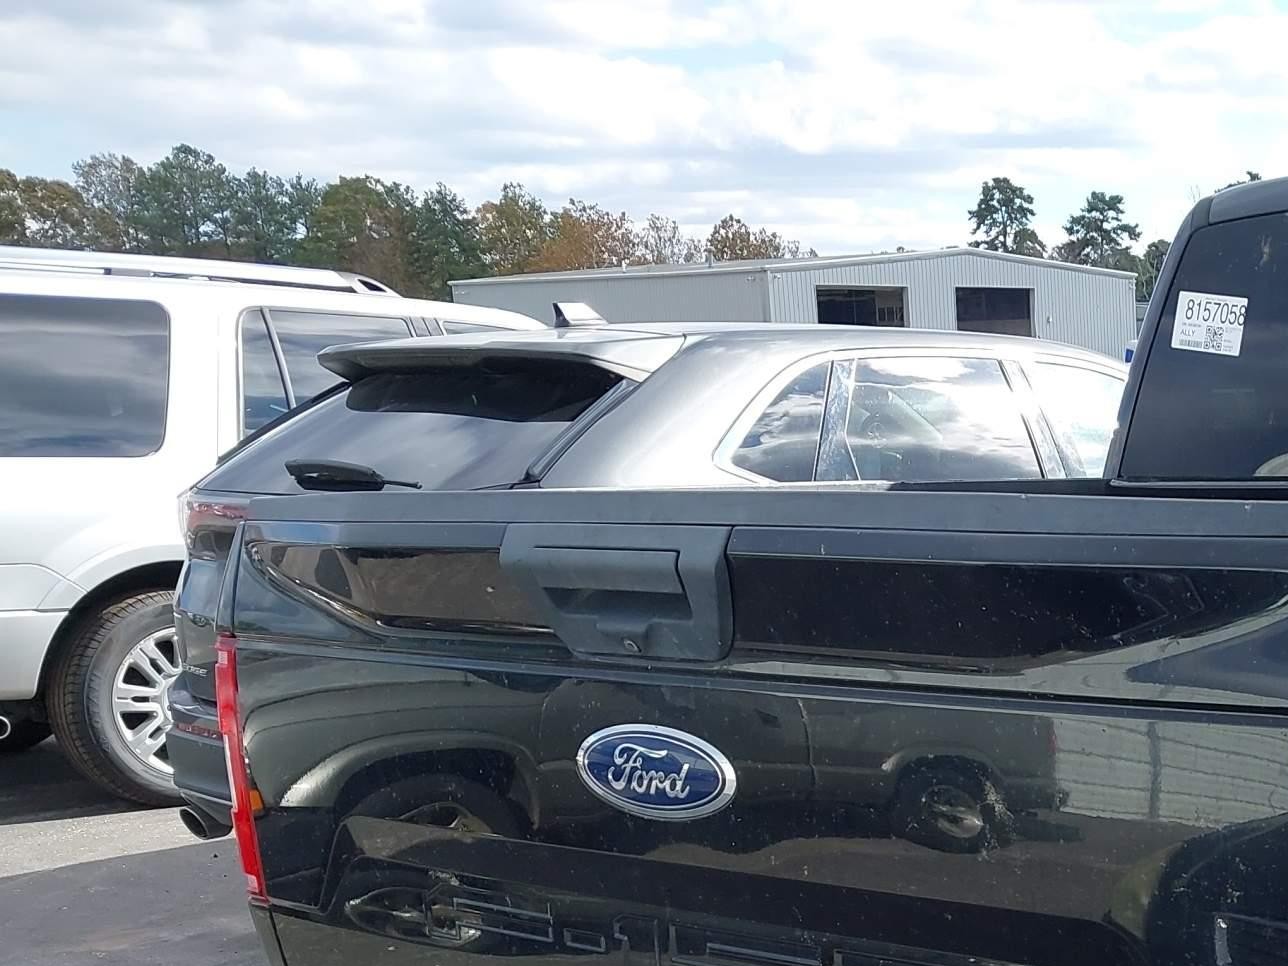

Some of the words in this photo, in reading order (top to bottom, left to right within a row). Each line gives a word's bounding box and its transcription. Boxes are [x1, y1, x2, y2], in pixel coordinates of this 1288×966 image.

[1185, 298, 1247, 326] 8157058
[1180, 328, 1196, 337] ALLY
[607, 743, 691, 799] Ford
